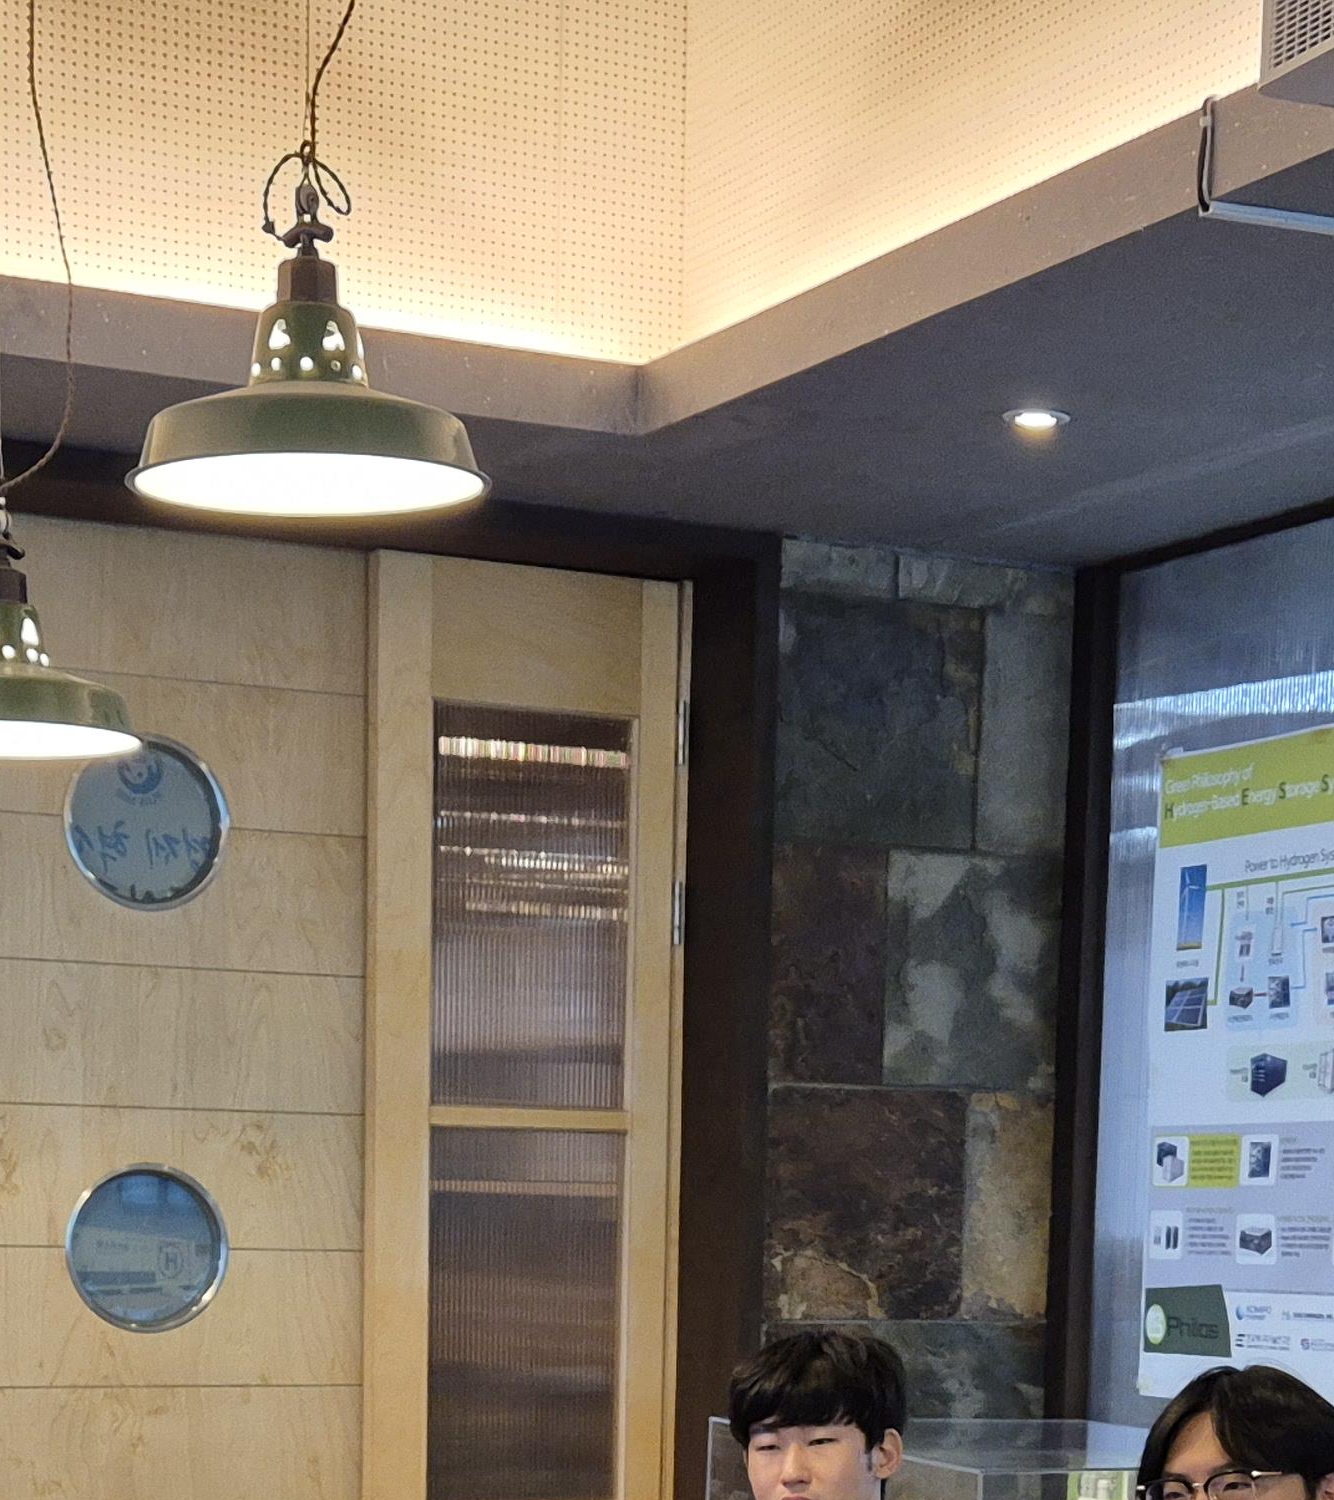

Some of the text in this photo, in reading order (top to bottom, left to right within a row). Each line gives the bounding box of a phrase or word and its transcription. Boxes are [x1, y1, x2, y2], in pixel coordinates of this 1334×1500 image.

[1241, 787, 1277, 808] Energy
[1278, 781, 1320, 800] Storage
[1244, 857, 1269, 873] Power
[1279, 850, 1320, 871] Hydrogen
